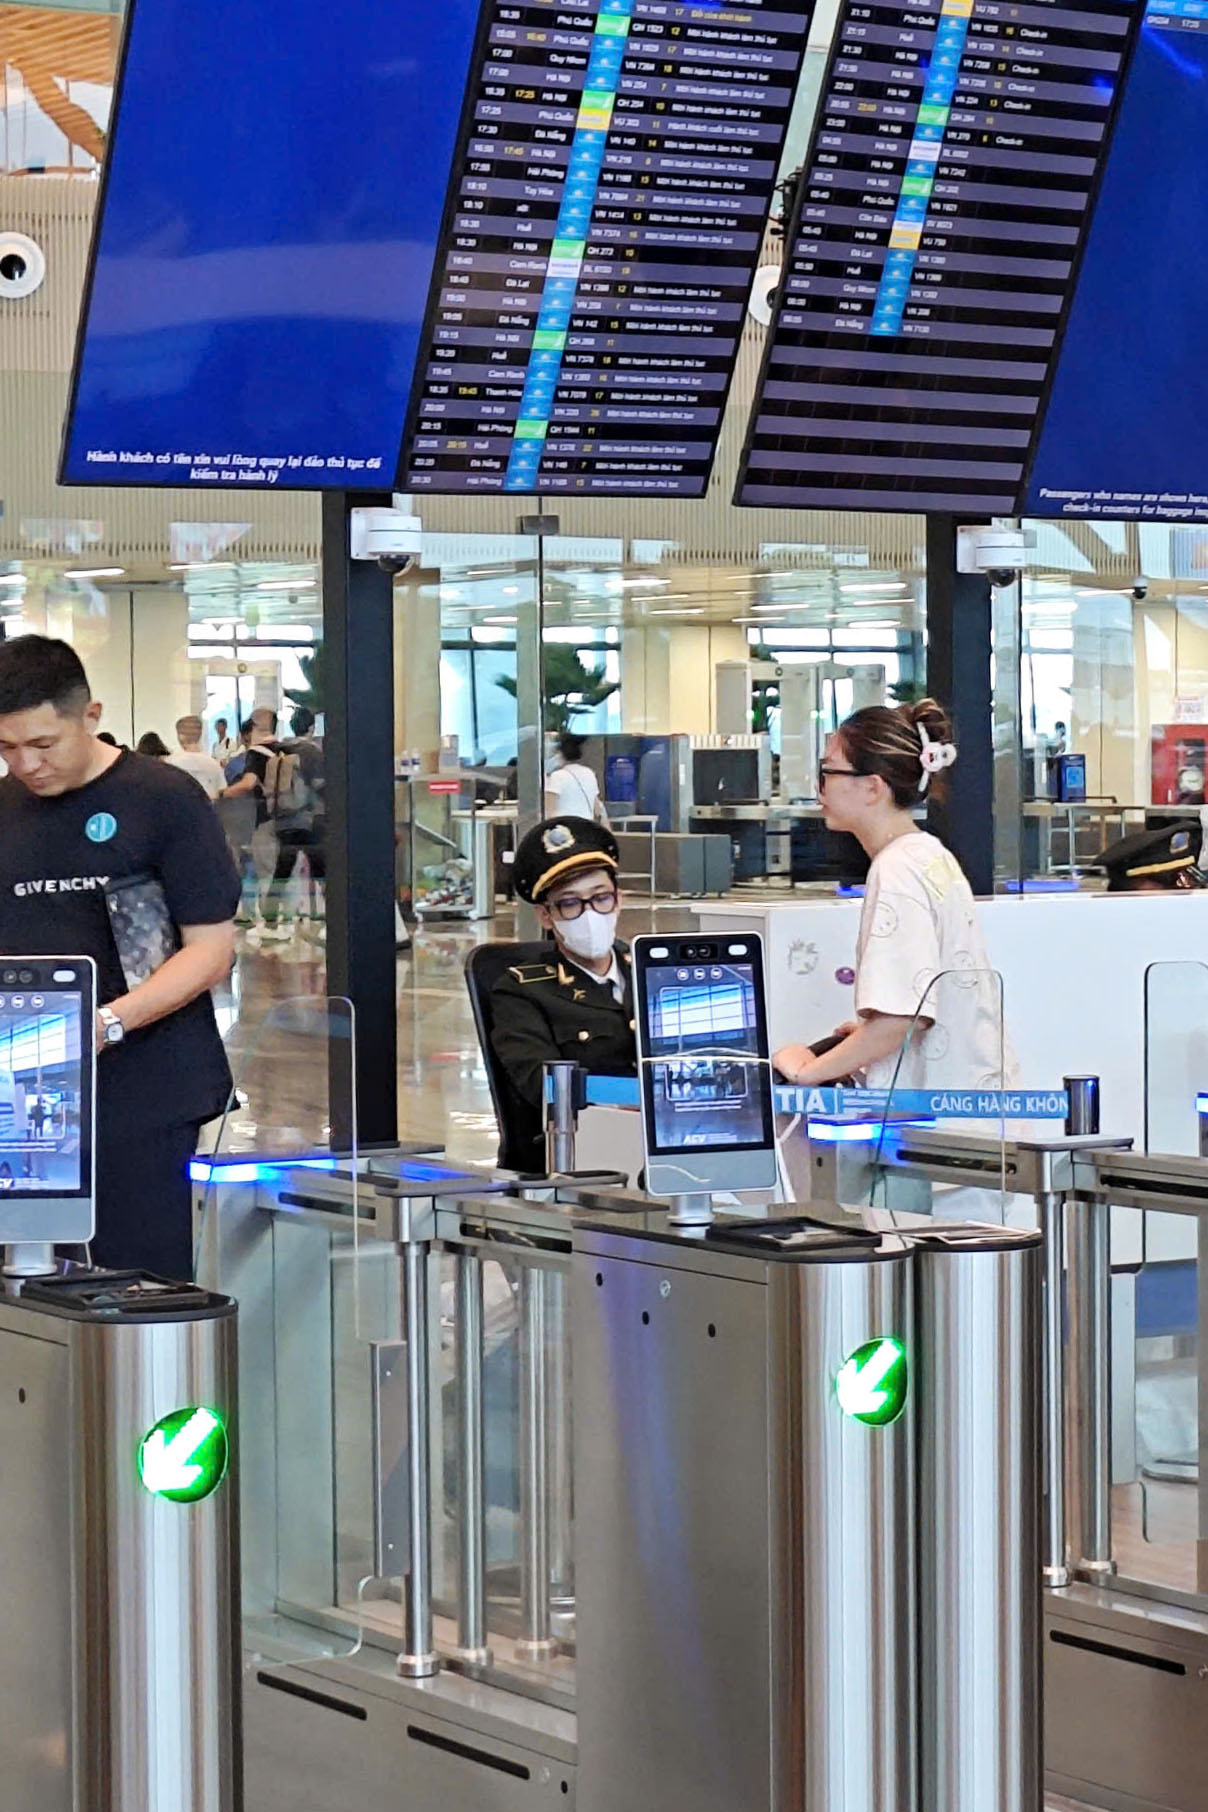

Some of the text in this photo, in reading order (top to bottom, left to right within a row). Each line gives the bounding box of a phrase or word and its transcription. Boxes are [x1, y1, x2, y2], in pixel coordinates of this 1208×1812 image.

[87, 450, 117, 462] Hành
[119, 452, 154, 462] khách
[156, 453, 170, 463] có
[174, 453, 191, 464] tên
[1040, 488, 1091, 500] Passengers
[1094, 490, 1111, 499] who
[1159, 493, 1187, 502] shown
[1063, 502, 1101, 512] check-in
[1102, 506, 1140, 514] counters
[1142, 505, 1155, 514] for
[1156, 505, 1193, 517] baggage
[775, 1088, 828, 1113] TIA
[978, 1092, 1021, 1112] HÀNG
